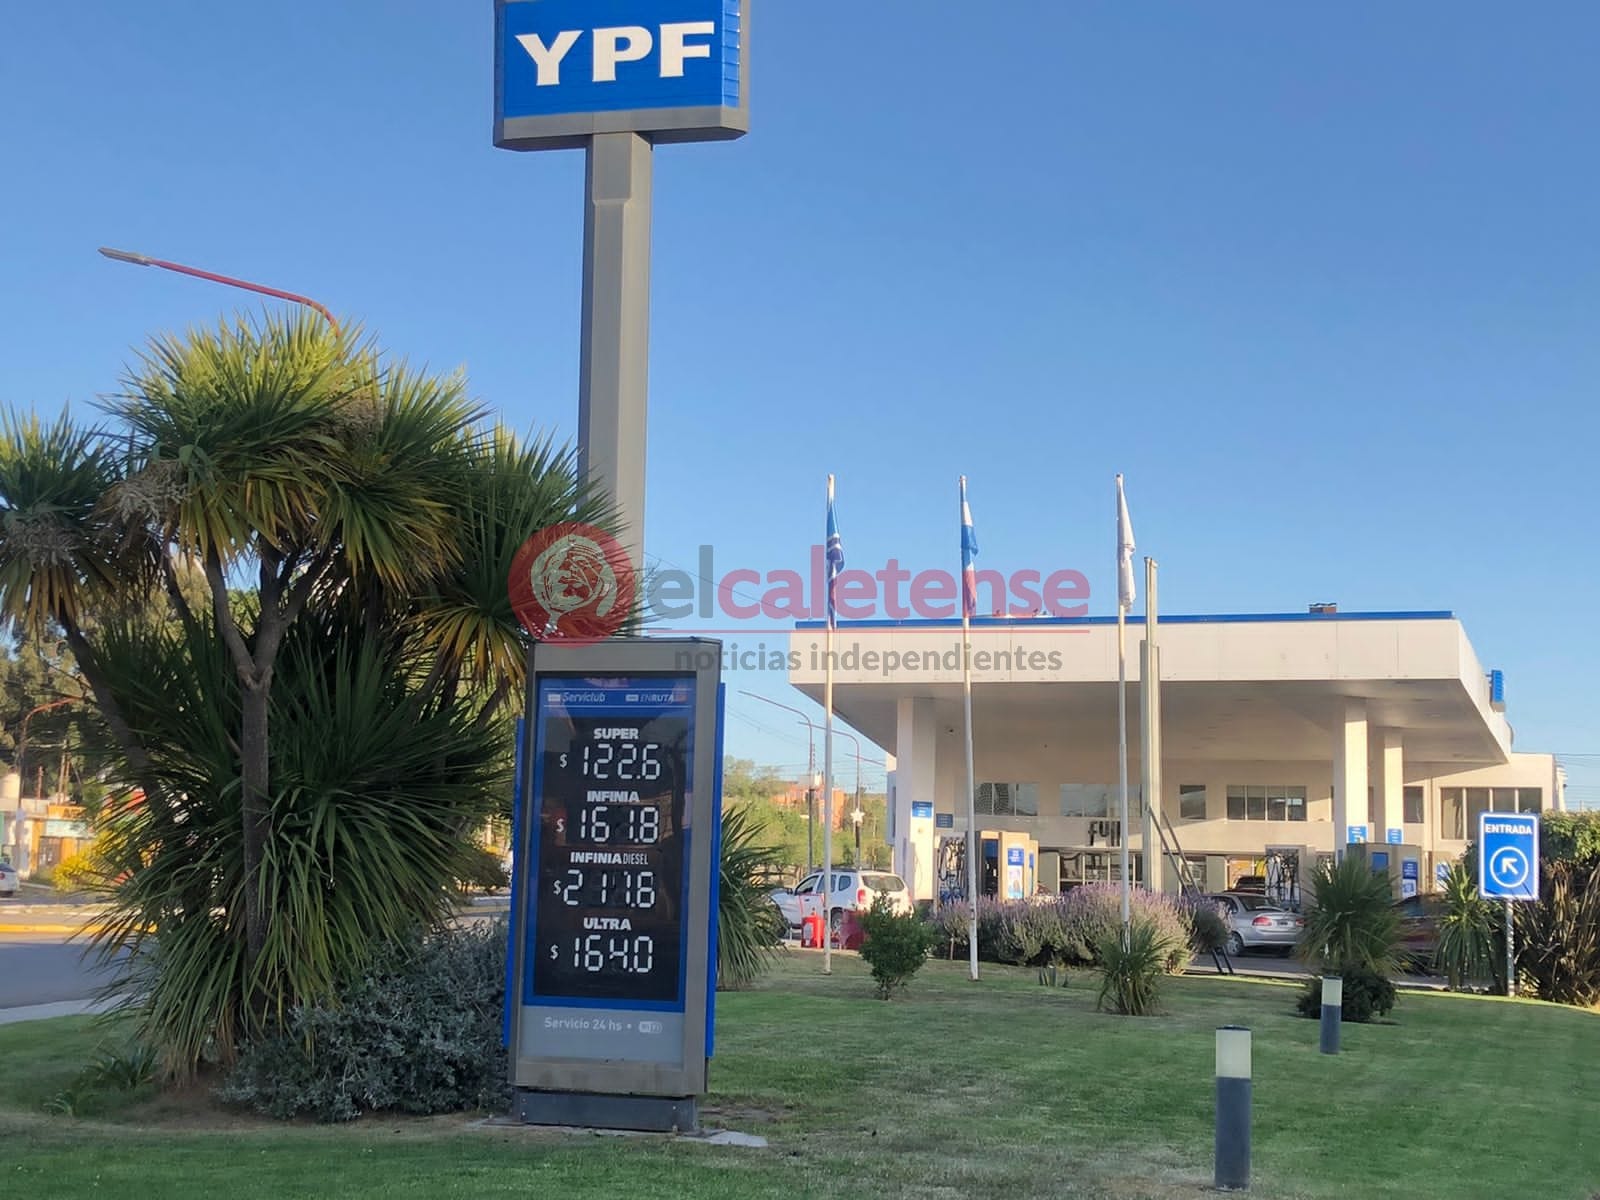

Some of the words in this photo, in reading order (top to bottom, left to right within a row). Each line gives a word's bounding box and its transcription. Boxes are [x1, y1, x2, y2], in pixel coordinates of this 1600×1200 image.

[515, 21, 715, 86] YPF
[563, 692, 606, 703] Serviclub
[593, 728, 639, 740] SUPER
[559, 754, 568, 768] $
[583, 743, 661, 780] 122.6
[587, 791, 640, 802] INFINIA
[556, 818, 565, 833] $
[581, 806, 659, 843] 161.8
[1484, 823, 1533, 836] ENTRADA
[570, 851, 622, 864] INFINIA
[623, 853, 649, 865] DIESEL
[553, 880, 561, 895] $
[563, 869, 656, 908] 211.6
[583, 917, 632, 931] ULTRA
[550, 944, 559, 960] $
[574, 934, 653, 973] 164.0
[544, 1017, 589, 1029] Servicio
[592, 1019, 607, 1030] 24
[608, 1020, 623, 1032] hs
